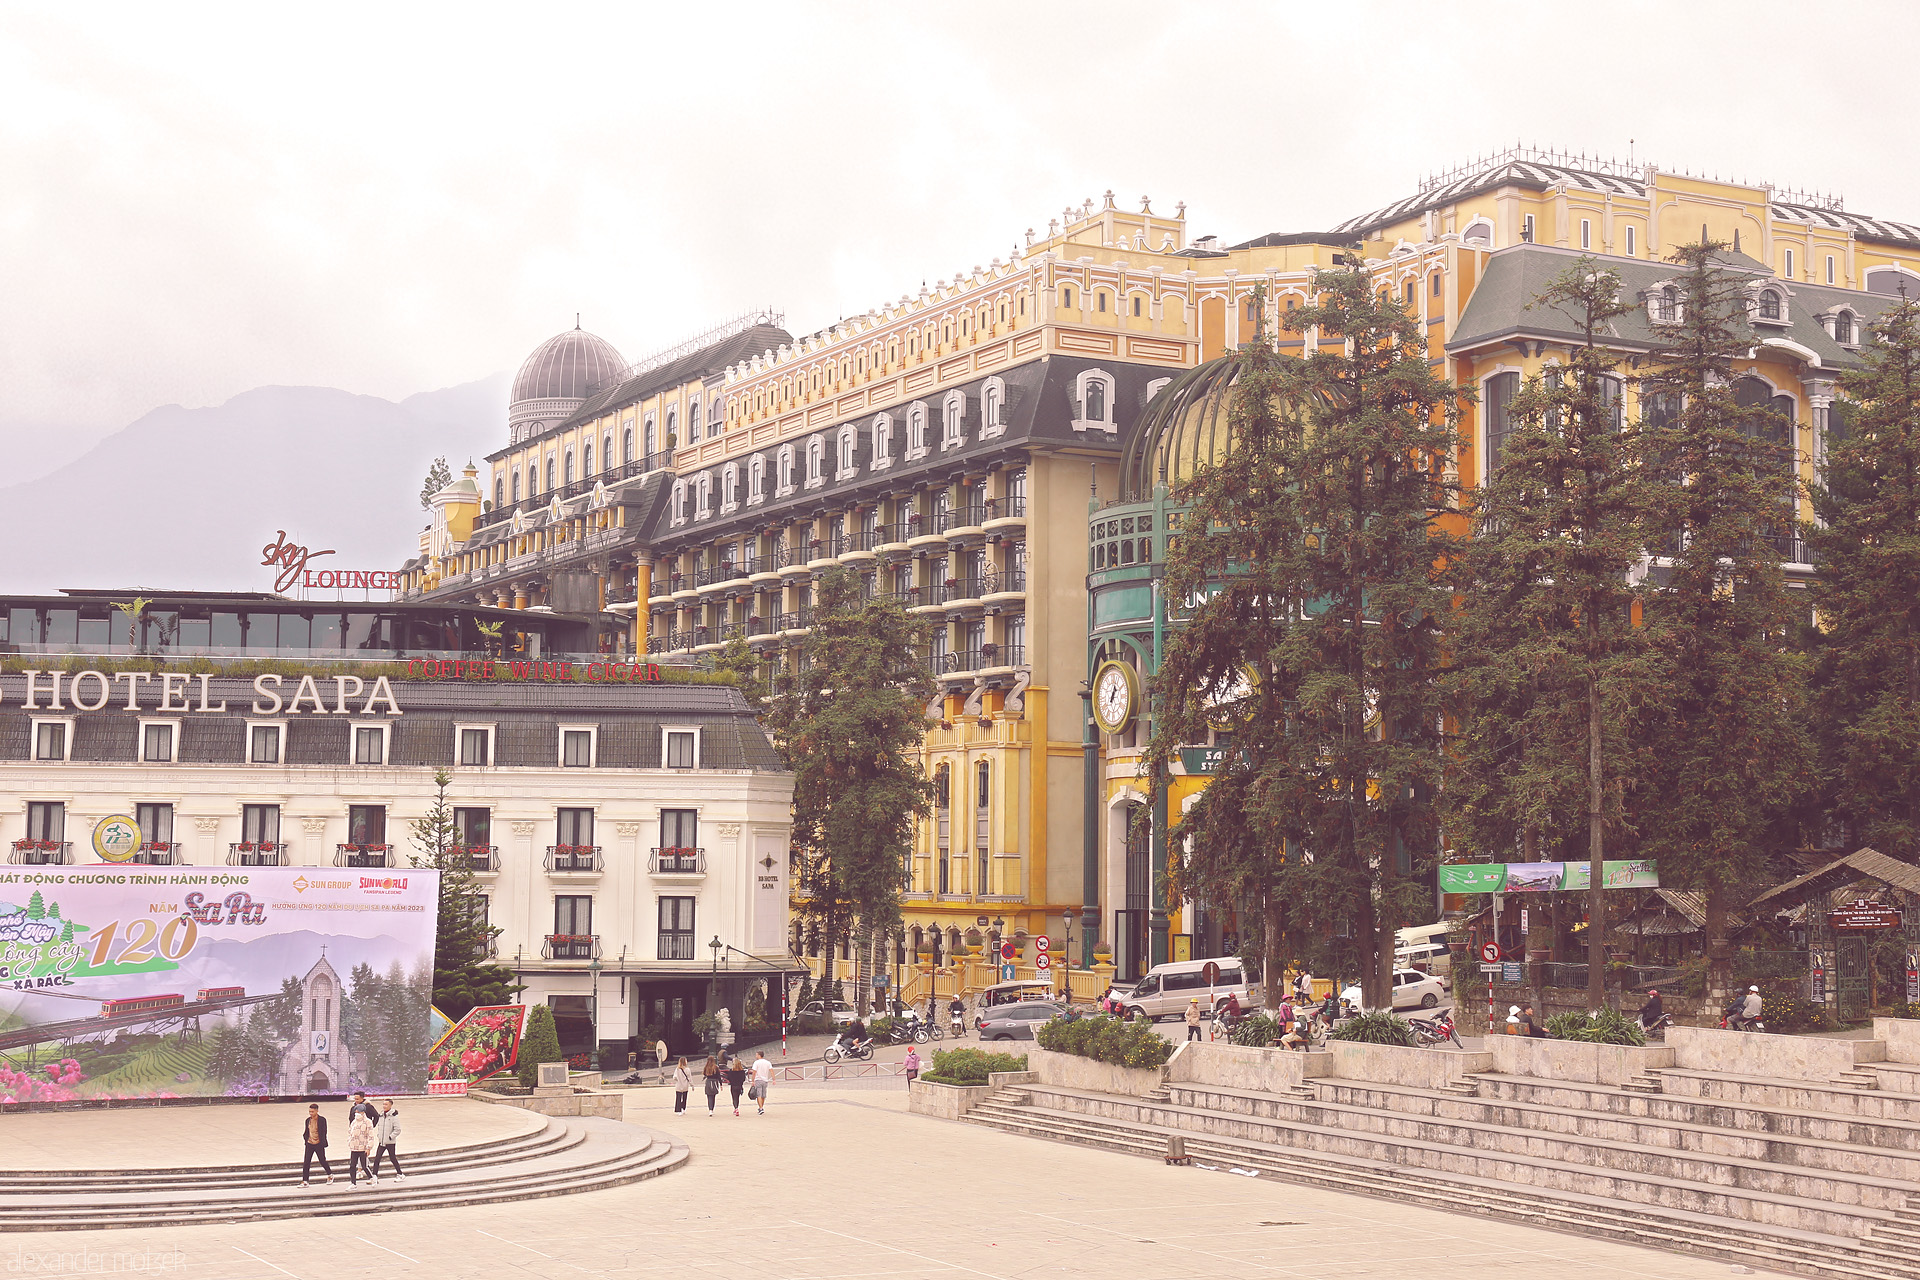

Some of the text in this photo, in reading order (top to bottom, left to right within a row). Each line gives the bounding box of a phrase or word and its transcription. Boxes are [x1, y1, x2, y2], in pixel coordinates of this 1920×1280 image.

[303, 570, 401, 589] LOUNGE
[408, 659, 661, 682] COFFEE WINE CIGAR
[21, 669, 226, 713] HOTEL
[252, 673, 404, 716] SAPA
[22, 872, 65, 886] ĐỘNG
[68, 874, 126, 885] CHƯƠNG
[129, 873, 167, 886] TRÌNH
[170, 874, 208, 886] HÀNH
[210, 873, 250, 888] ĐỘNG
[310, 880, 352, 889] SUN GROUP
[1608, 870, 1635, 885] 120
[149, 900, 178, 914] NĂM
[89, 918, 198, 967] 120
[49, 941, 83, 972] cây
[37, 973, 63, 987] RÁC
